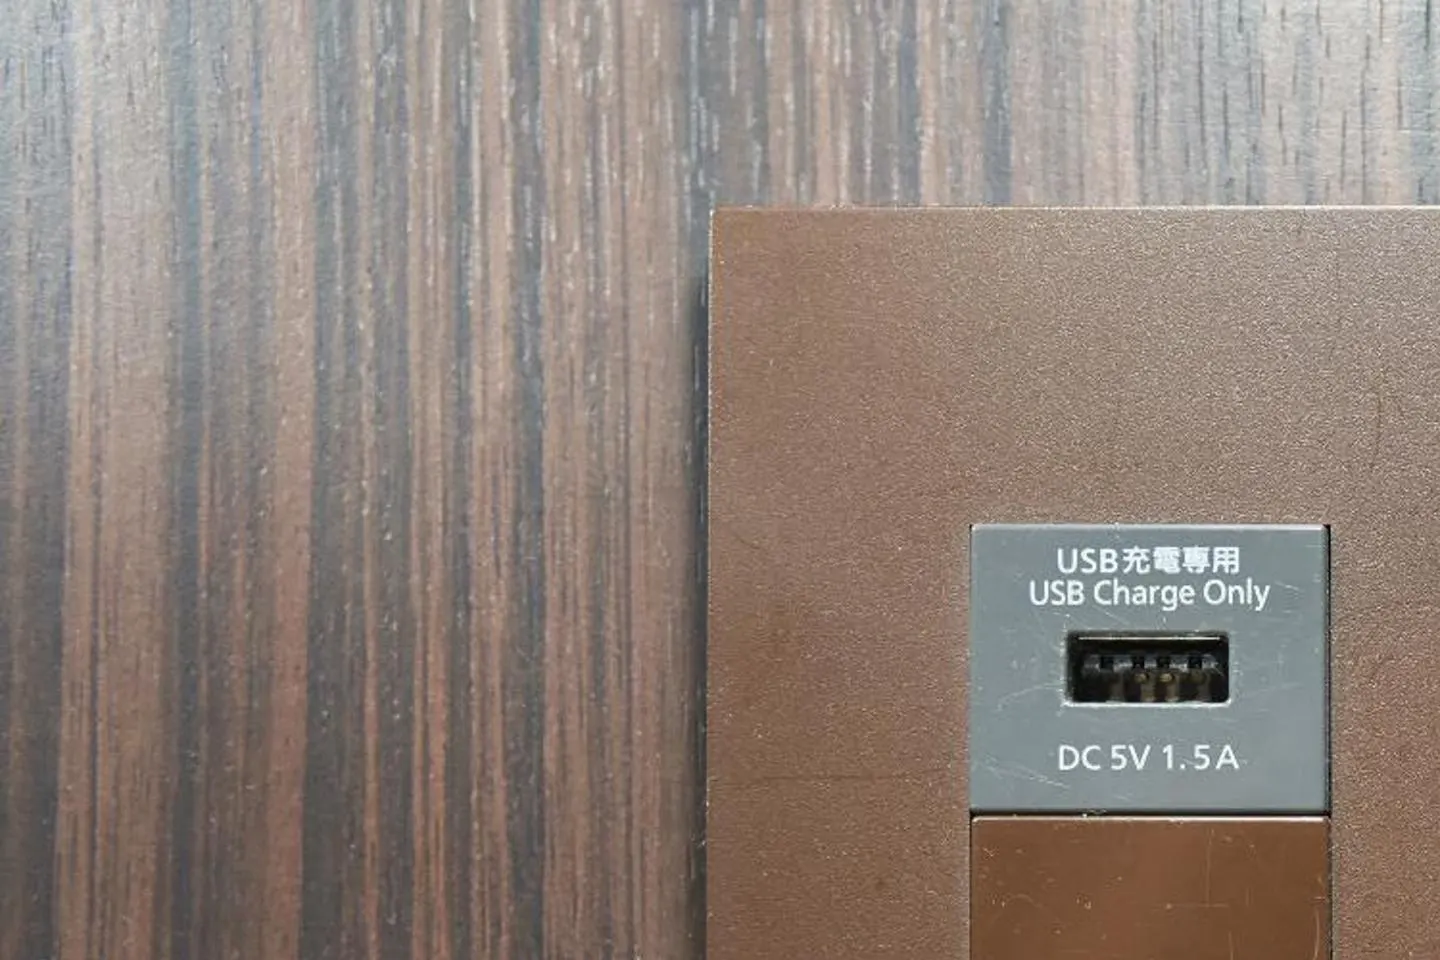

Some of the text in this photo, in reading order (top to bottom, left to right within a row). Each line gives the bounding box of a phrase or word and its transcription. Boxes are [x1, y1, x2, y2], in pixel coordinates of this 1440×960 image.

[1029, 577, 1271, 611] USB Charge Only
[1058, 745, 1101, 771] DC
[1110, 745, 1151, 771] 5V
